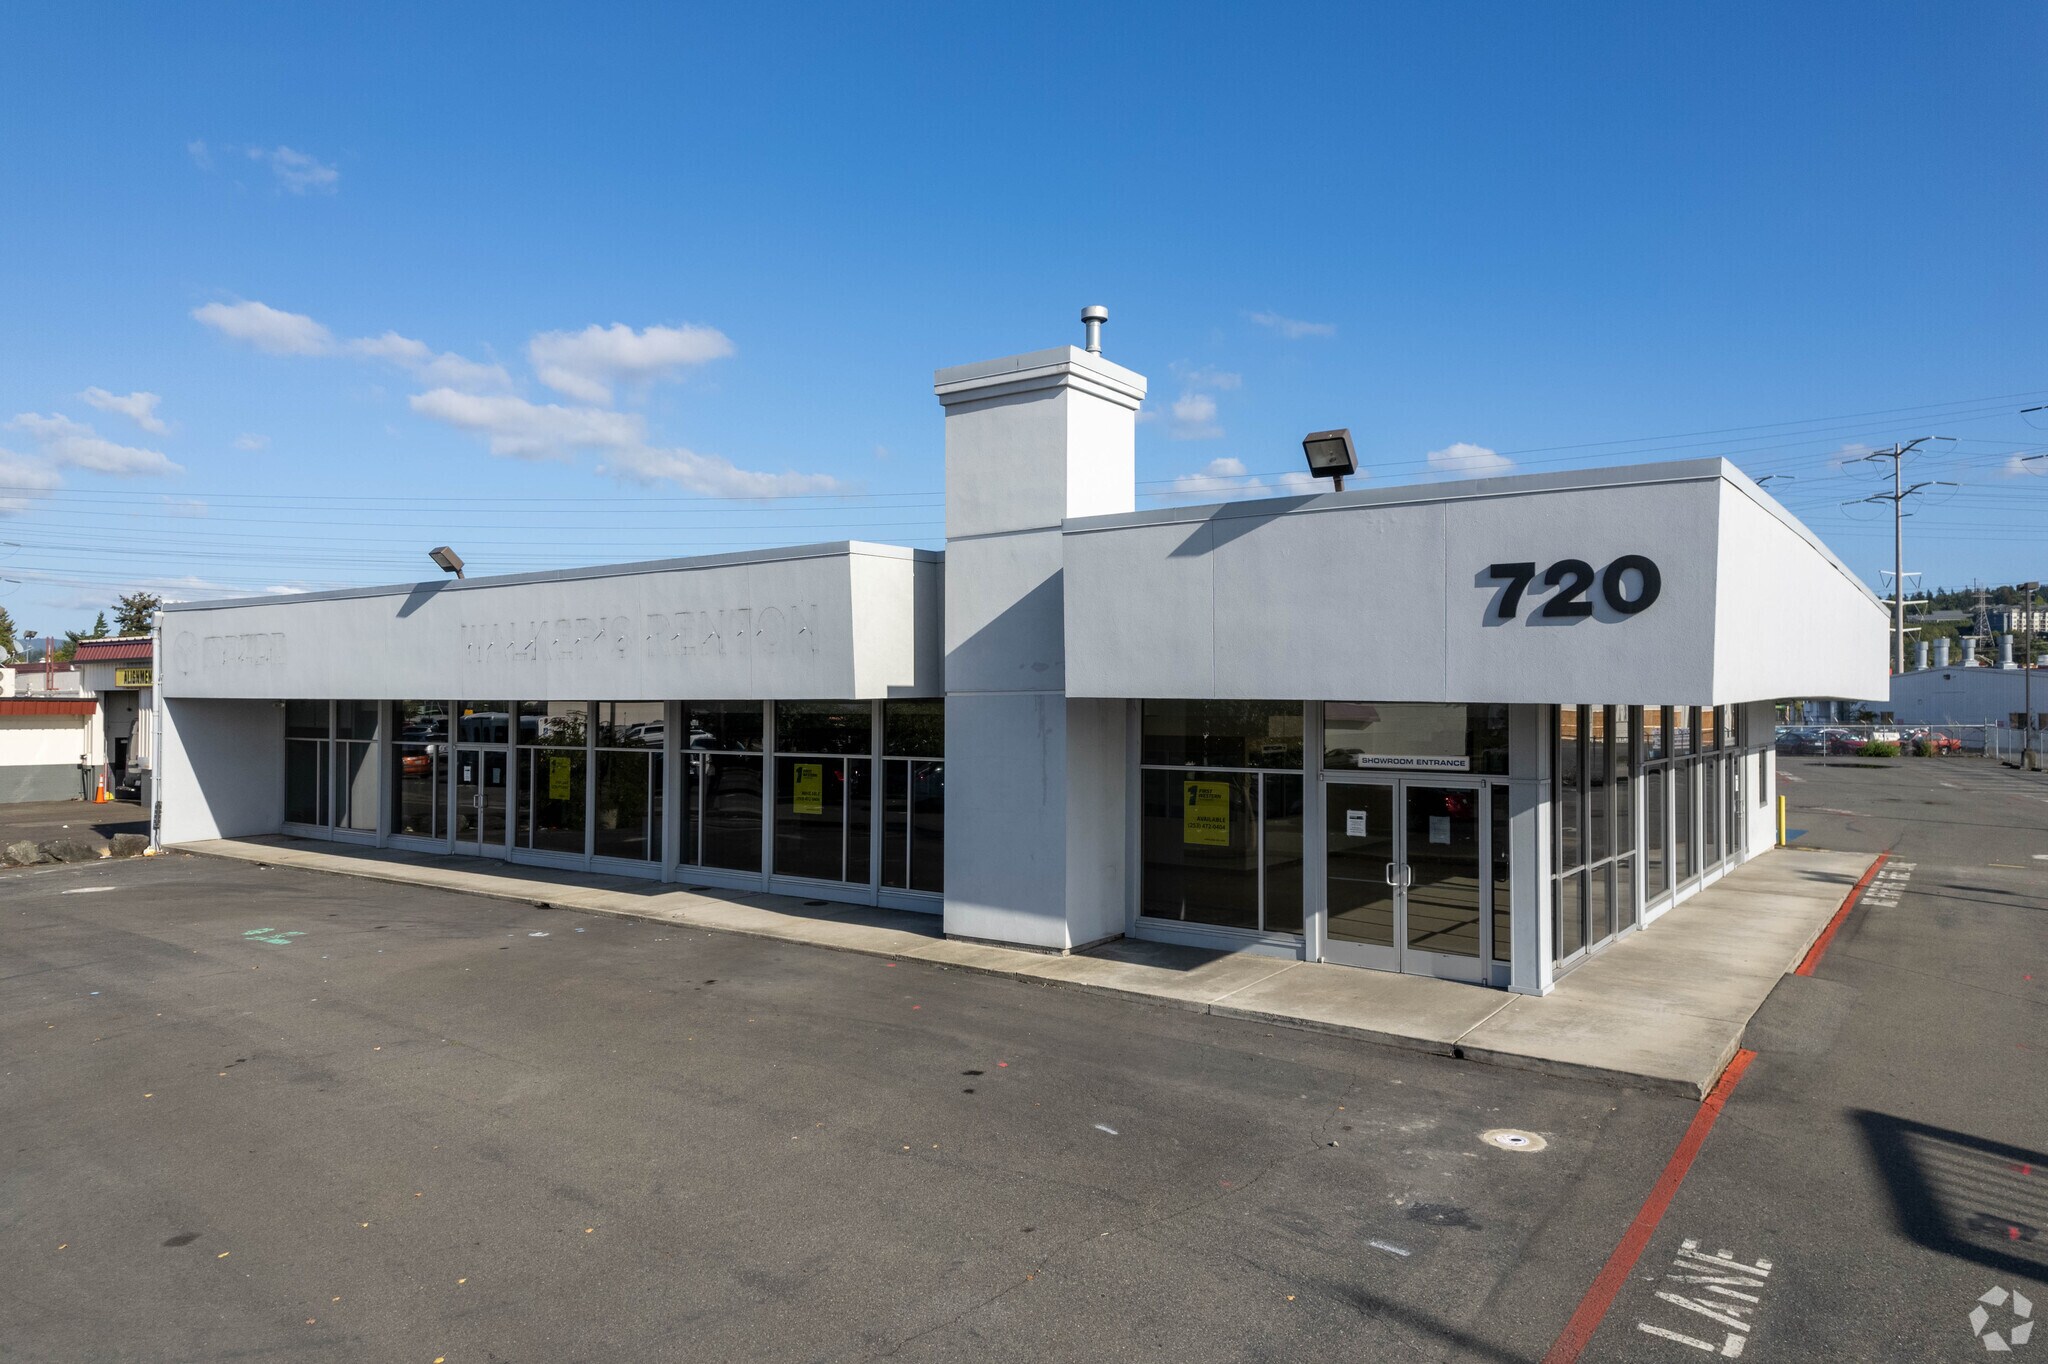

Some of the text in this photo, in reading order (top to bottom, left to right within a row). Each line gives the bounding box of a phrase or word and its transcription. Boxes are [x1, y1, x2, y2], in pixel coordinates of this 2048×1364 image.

[1490, 554, 1662, 618] 720
[124, 670, 153, 684] ALIGNMEN
[1361, 757, 1466, 767] SHOWROOM ENTRANCE
[1637, 1238, 1772, 1358] LANE
